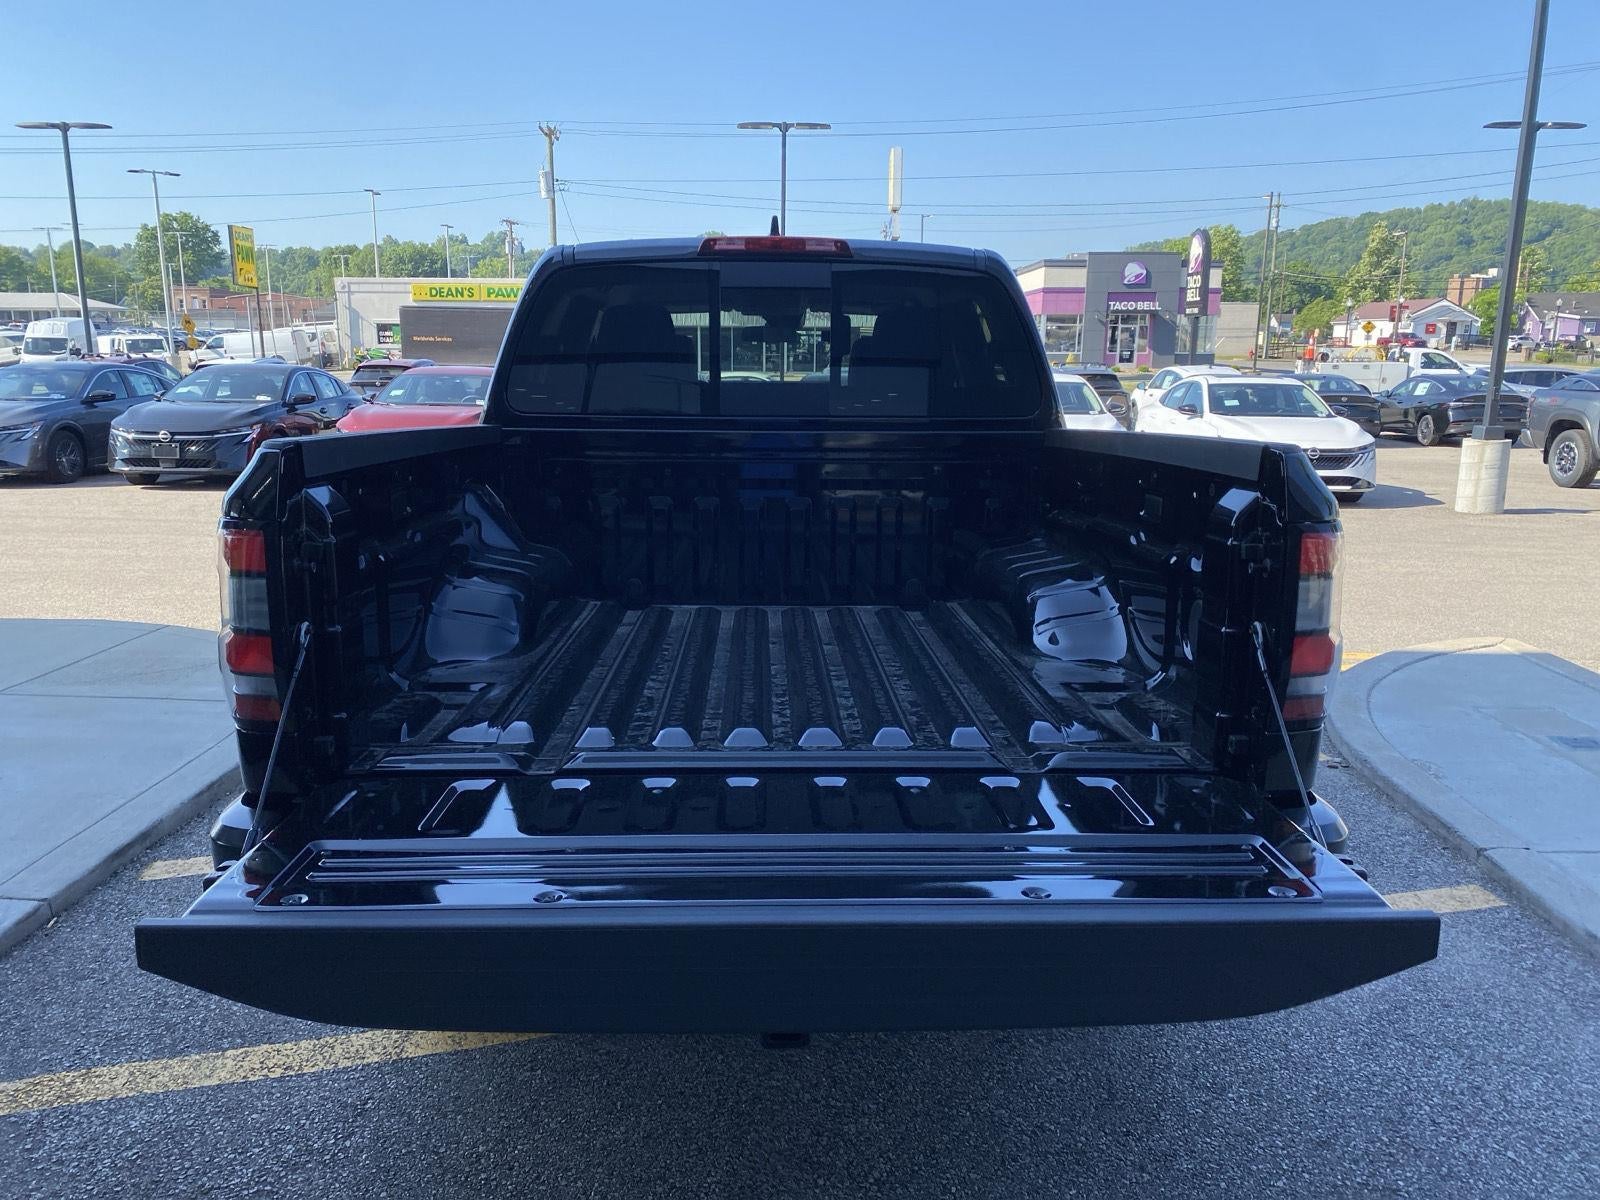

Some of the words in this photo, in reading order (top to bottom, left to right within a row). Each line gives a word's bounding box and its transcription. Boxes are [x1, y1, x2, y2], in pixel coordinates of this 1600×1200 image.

[236, 243, 255, 265] PAWN
[1187, 274, 1202, 288] TACO
[428, 286, 474, 298] DEAN'S
[1186, 288, 1200, 302] BELL
[1108, 301, 1136, 310] TACO
[1136, 301, 1162, 310] BELL
